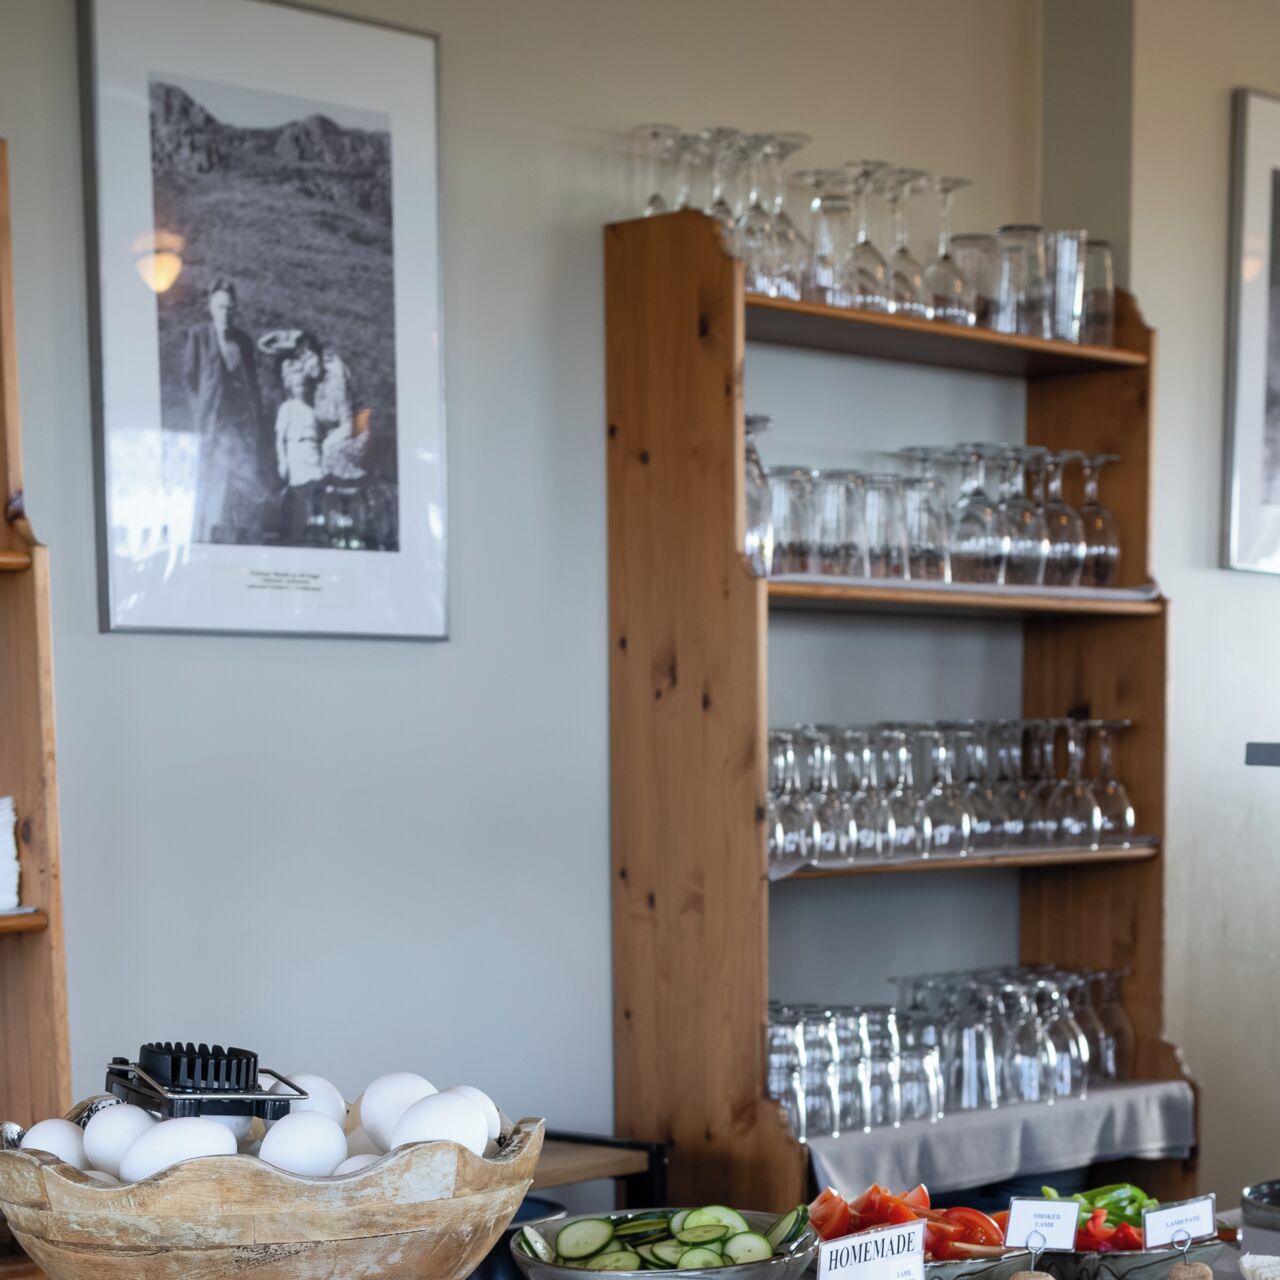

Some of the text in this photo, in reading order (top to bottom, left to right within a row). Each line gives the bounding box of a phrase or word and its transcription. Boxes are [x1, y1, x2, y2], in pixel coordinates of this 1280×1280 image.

[1165, 1219, 1184, 1228] LAMB
[827, 1231, 916, 1271] HOMEMADE
[896, 1269, 912, 1279] LAMB
